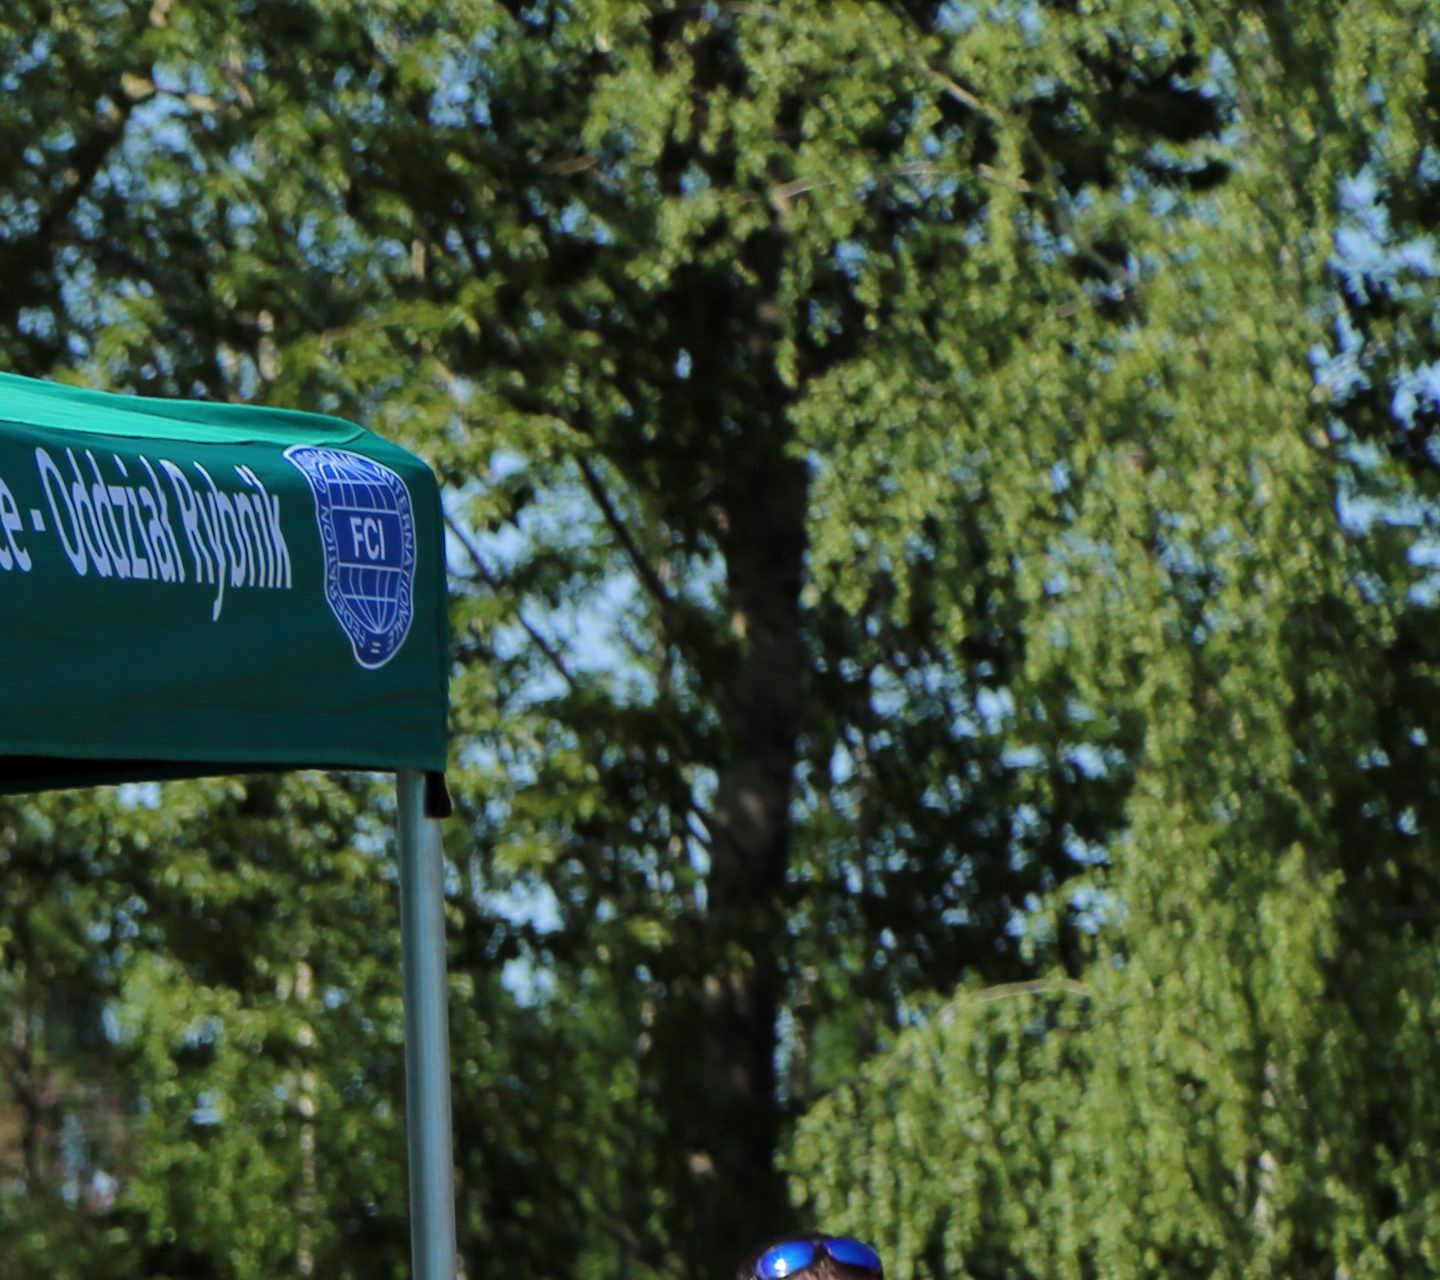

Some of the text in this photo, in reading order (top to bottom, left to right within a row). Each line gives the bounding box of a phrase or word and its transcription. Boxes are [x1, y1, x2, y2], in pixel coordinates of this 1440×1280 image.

[30, 509, 45, 531] -
[34, 447, 185, 583] Oddział
[159, 459, 291, 622] Rybnik
[350, 517, 385, 560] FCI
